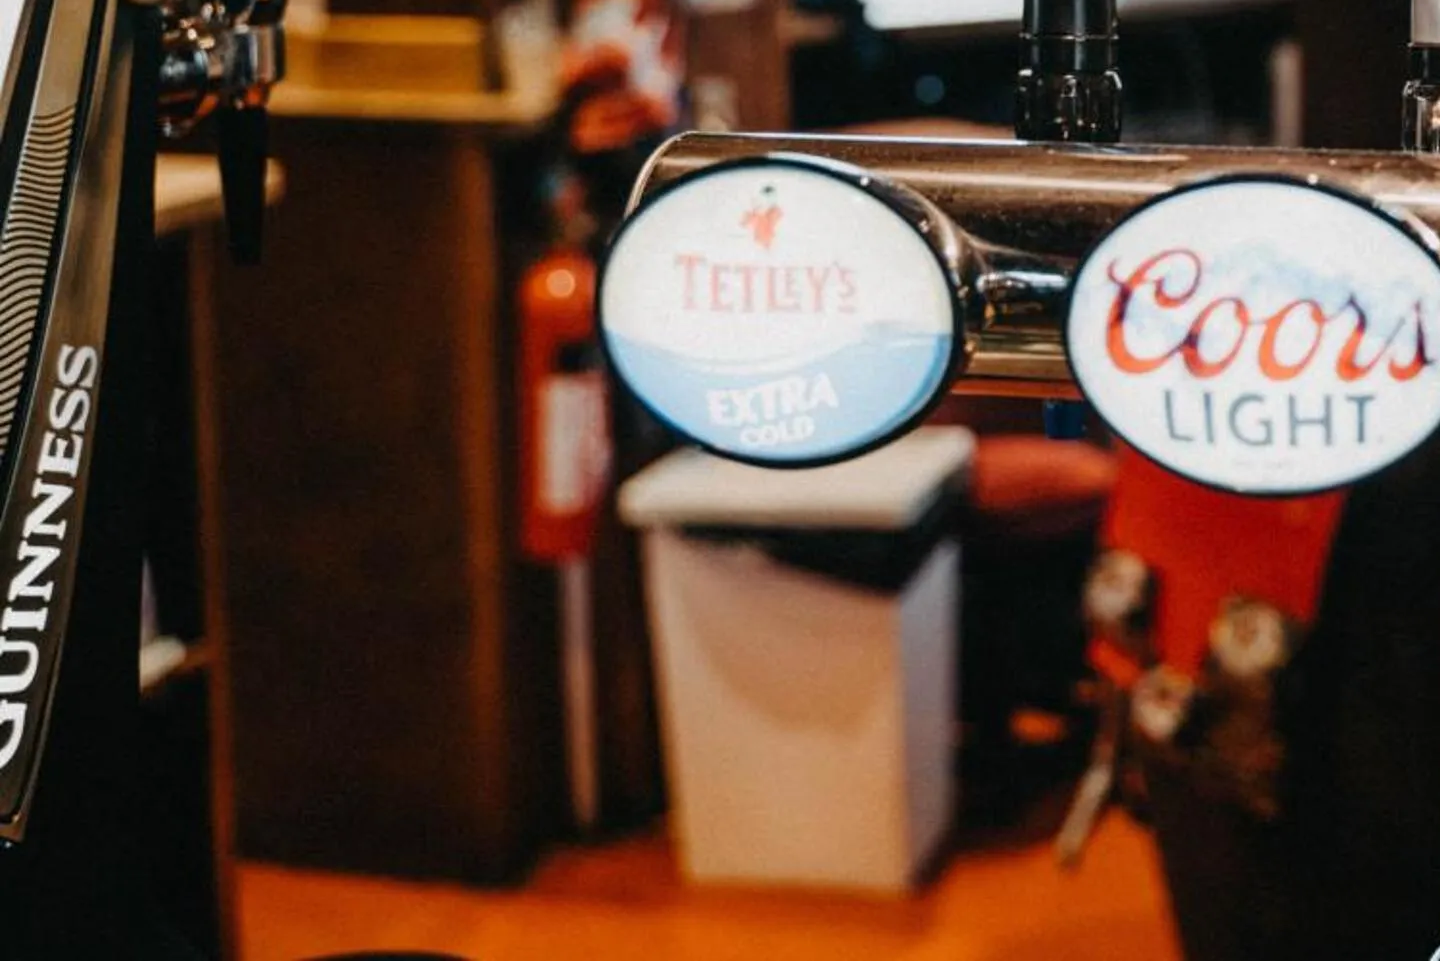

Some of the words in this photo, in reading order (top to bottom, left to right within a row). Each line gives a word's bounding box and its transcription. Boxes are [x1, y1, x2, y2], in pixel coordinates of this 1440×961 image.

[674, 254, 858, 314] TETLEY'S
[1105, 248, 1433, 382] Coors
[706, 372, 840, 428] EXTRA
[1164, 389, 1377, 447] LIGHT
[740, 415, 816, 446] COLD
